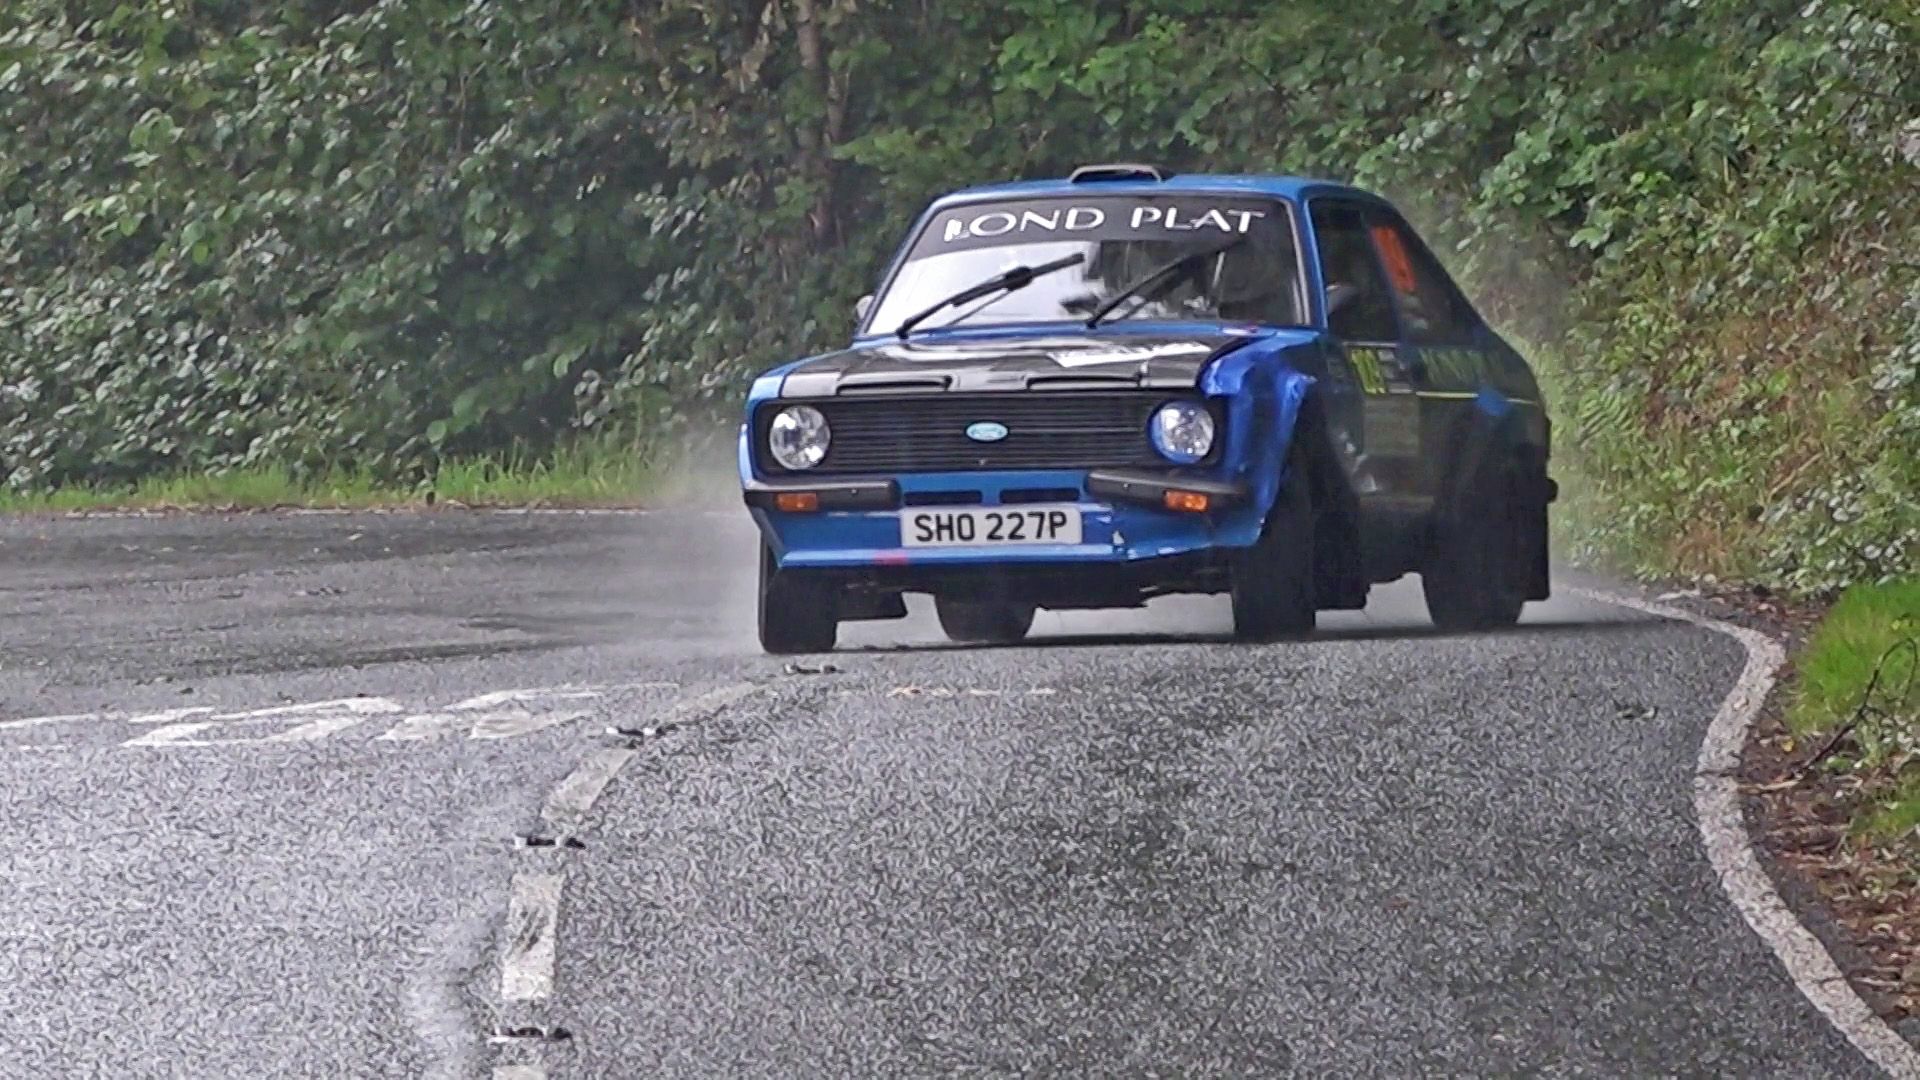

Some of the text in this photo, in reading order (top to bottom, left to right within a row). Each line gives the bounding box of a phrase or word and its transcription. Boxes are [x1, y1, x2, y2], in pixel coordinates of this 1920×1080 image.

[1130, 207, 1265, 233] PLAT
[914, 511, 1067, 542] SHO 227P
